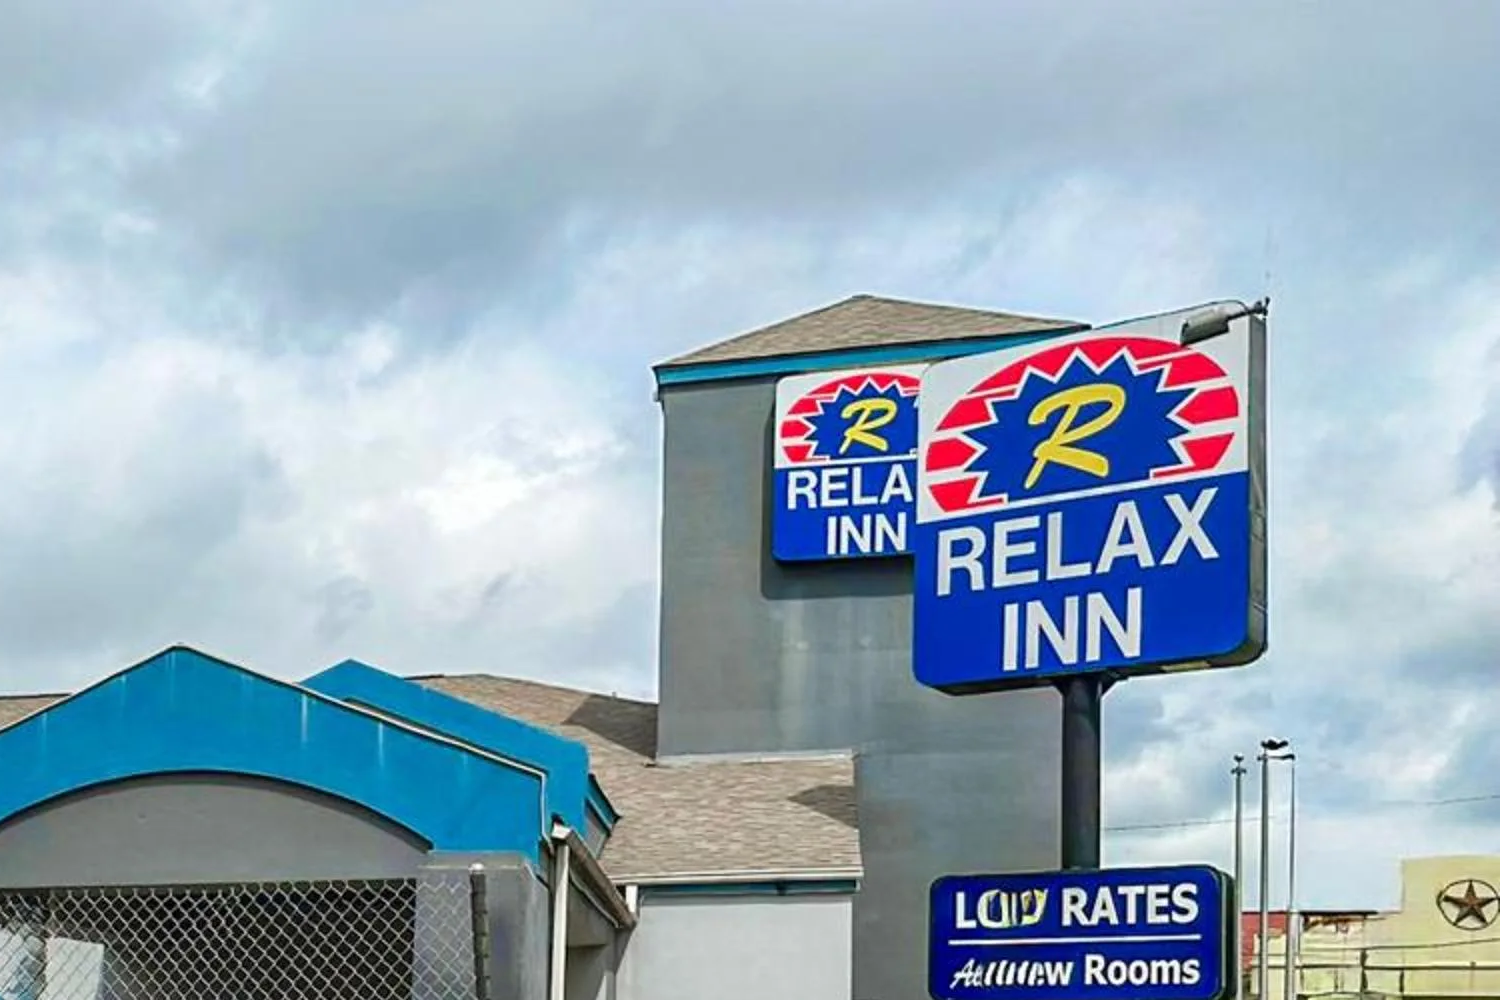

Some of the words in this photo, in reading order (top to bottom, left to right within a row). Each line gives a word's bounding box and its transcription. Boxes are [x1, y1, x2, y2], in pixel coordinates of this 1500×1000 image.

[839, 398, 898, 454] R
[1026, 384, 1126, 489] R
[787, 464, 914, 510] RELA
[827, 512, 907, 555] INN
[936, 488, 1219, 596] RELAX
[1002, 588, 1143, 672] INN
[1061, 883, 1199, 926] RATES
[1084, 953, 1200, 986] Rooms
